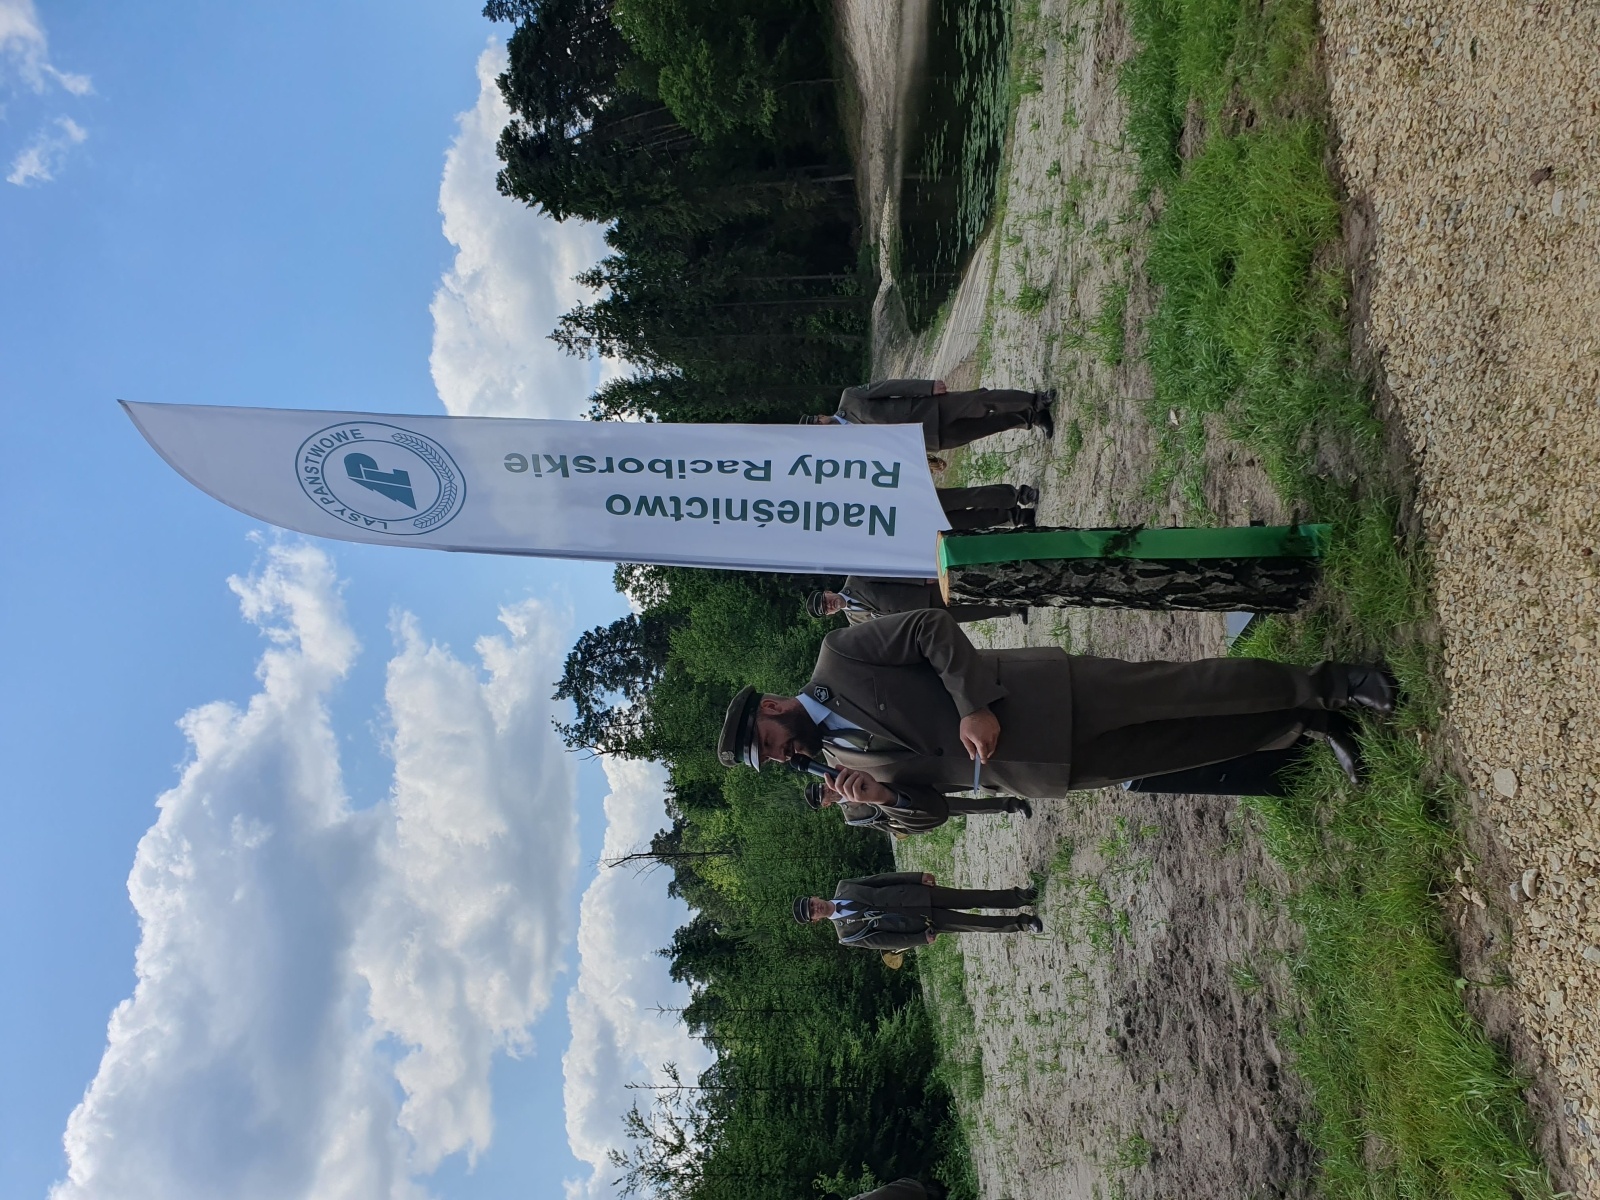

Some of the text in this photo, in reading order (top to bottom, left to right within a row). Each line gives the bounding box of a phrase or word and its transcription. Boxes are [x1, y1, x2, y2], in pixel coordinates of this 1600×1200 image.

[304, 428, 388, 530] LASY PAŃSTWOWE
[503, 452, 901, 488] Rudy Raciborskie
[605, 493, 897, 537] Nadleśnictwo
